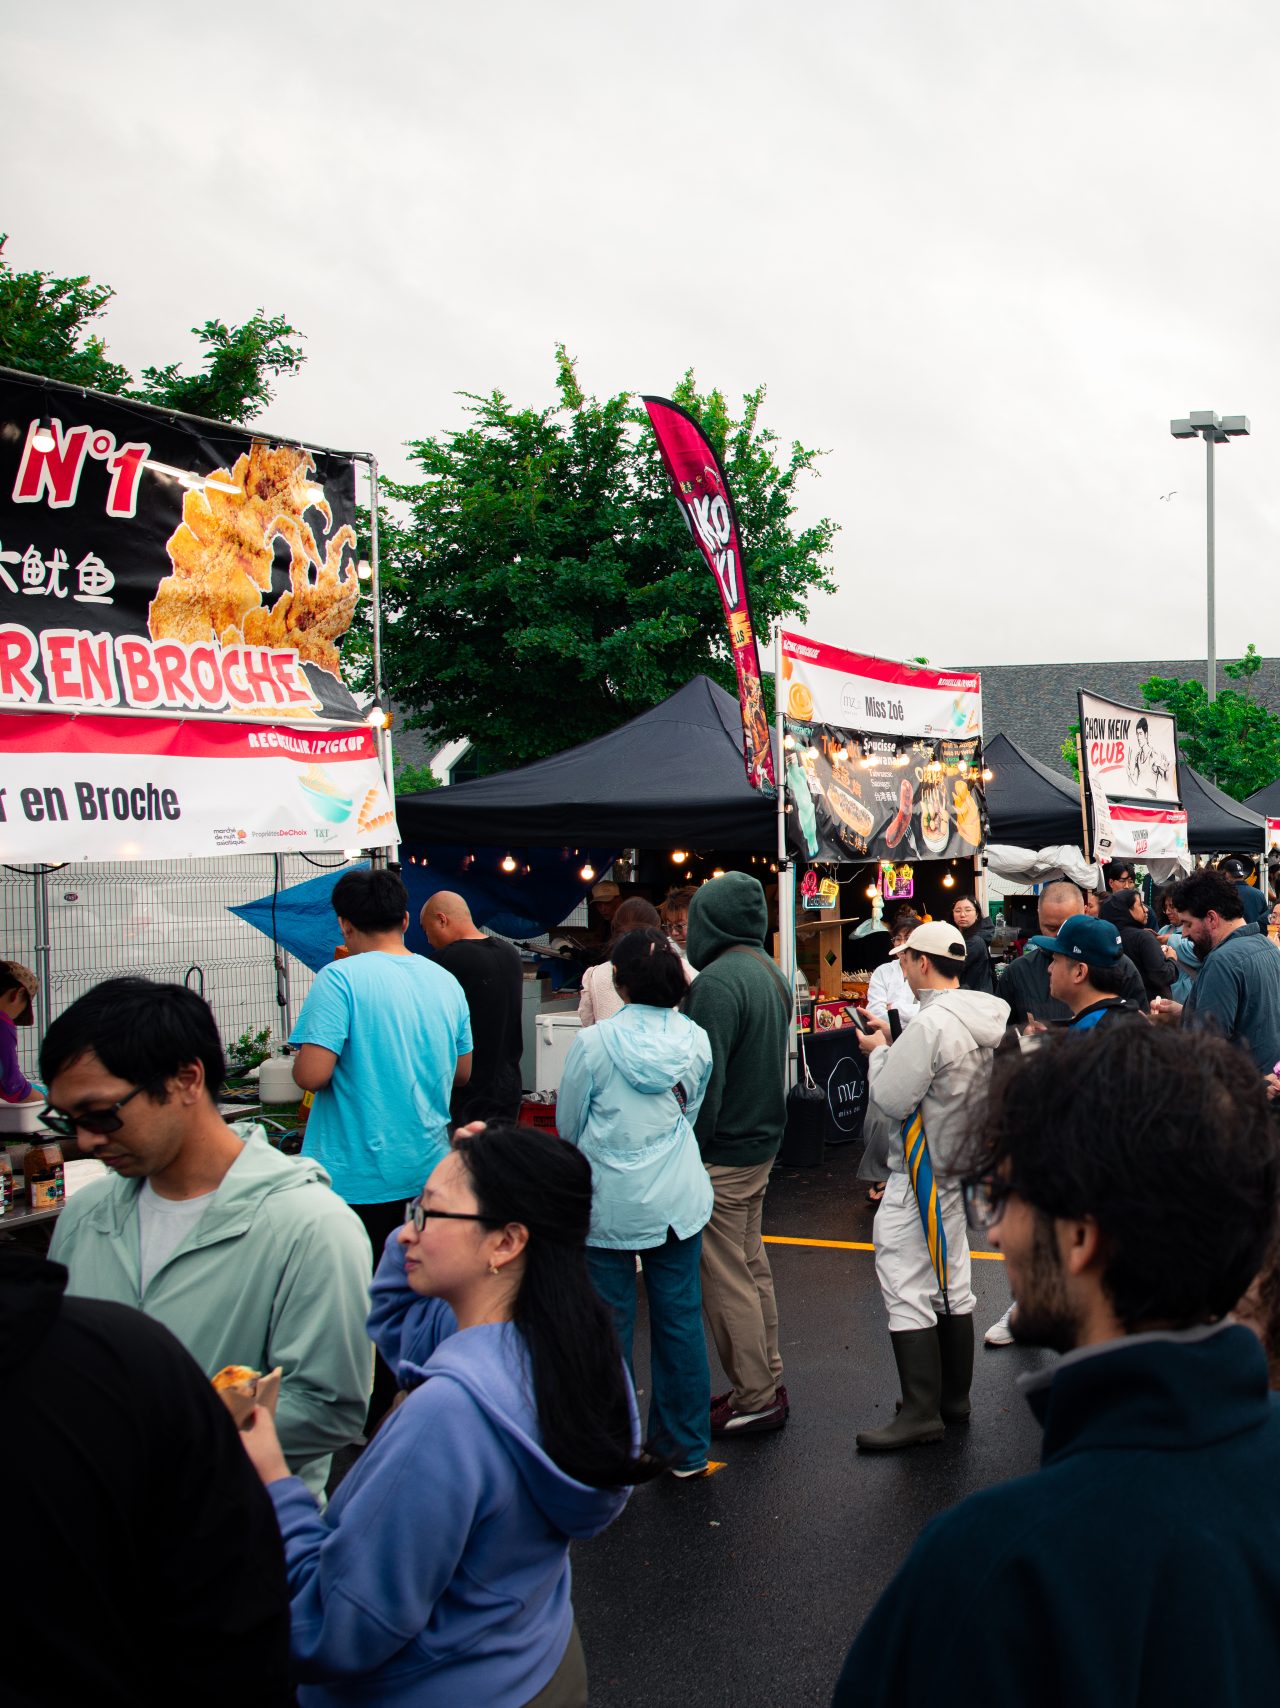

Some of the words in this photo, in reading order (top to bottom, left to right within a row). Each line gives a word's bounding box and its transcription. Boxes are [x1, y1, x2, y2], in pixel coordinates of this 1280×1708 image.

[43, 632, 114, 702] EN
[118, 638, 318, 707] BROCHE
[865, 696, 887, 719] Miss
[1085, 717, 1105, 740] CHOW
[1107, 718, 1131, 740] MEIN
[1091, 741, 1125, 767] CLUB
[20, 787, 68, 822] en
[75, 781, 181, 822] Broche
